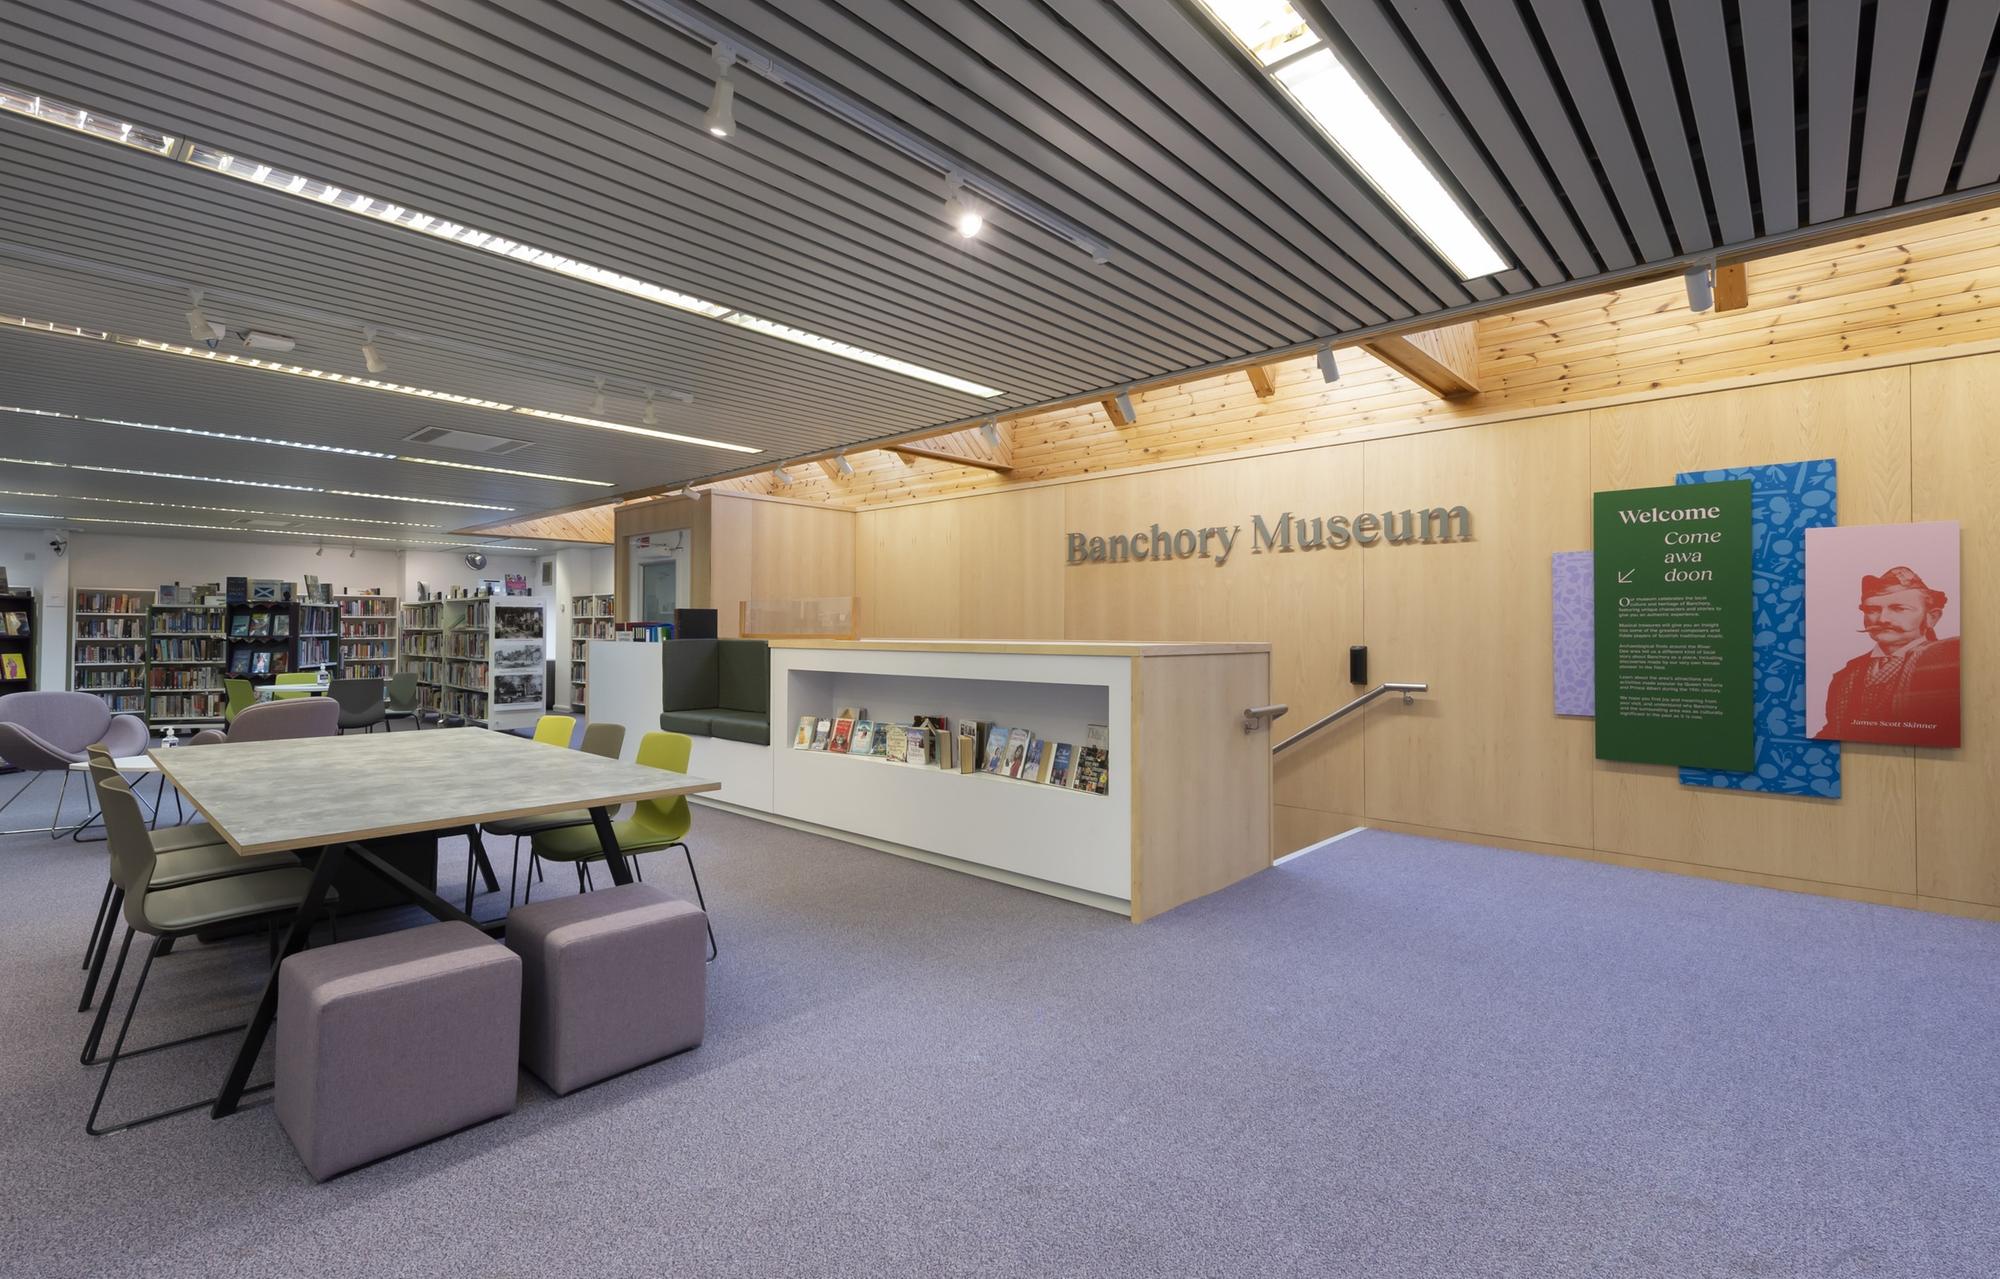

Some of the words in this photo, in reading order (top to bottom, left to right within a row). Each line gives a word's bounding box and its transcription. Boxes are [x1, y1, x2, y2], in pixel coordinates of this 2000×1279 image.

[1618, 506, 1720, 524] Welcome
[1066, 523, 1241, 567] Banchory
[1250, 504, 1474, 555] Museum
[1664, 531, 1722, 545] Come
[1664, 551, 1702, 564] awa
[1664, 568, 1713, 582] doon
[1851, 719, 1878, 727] James
[1903, 721, 1937, 729] Skinner
